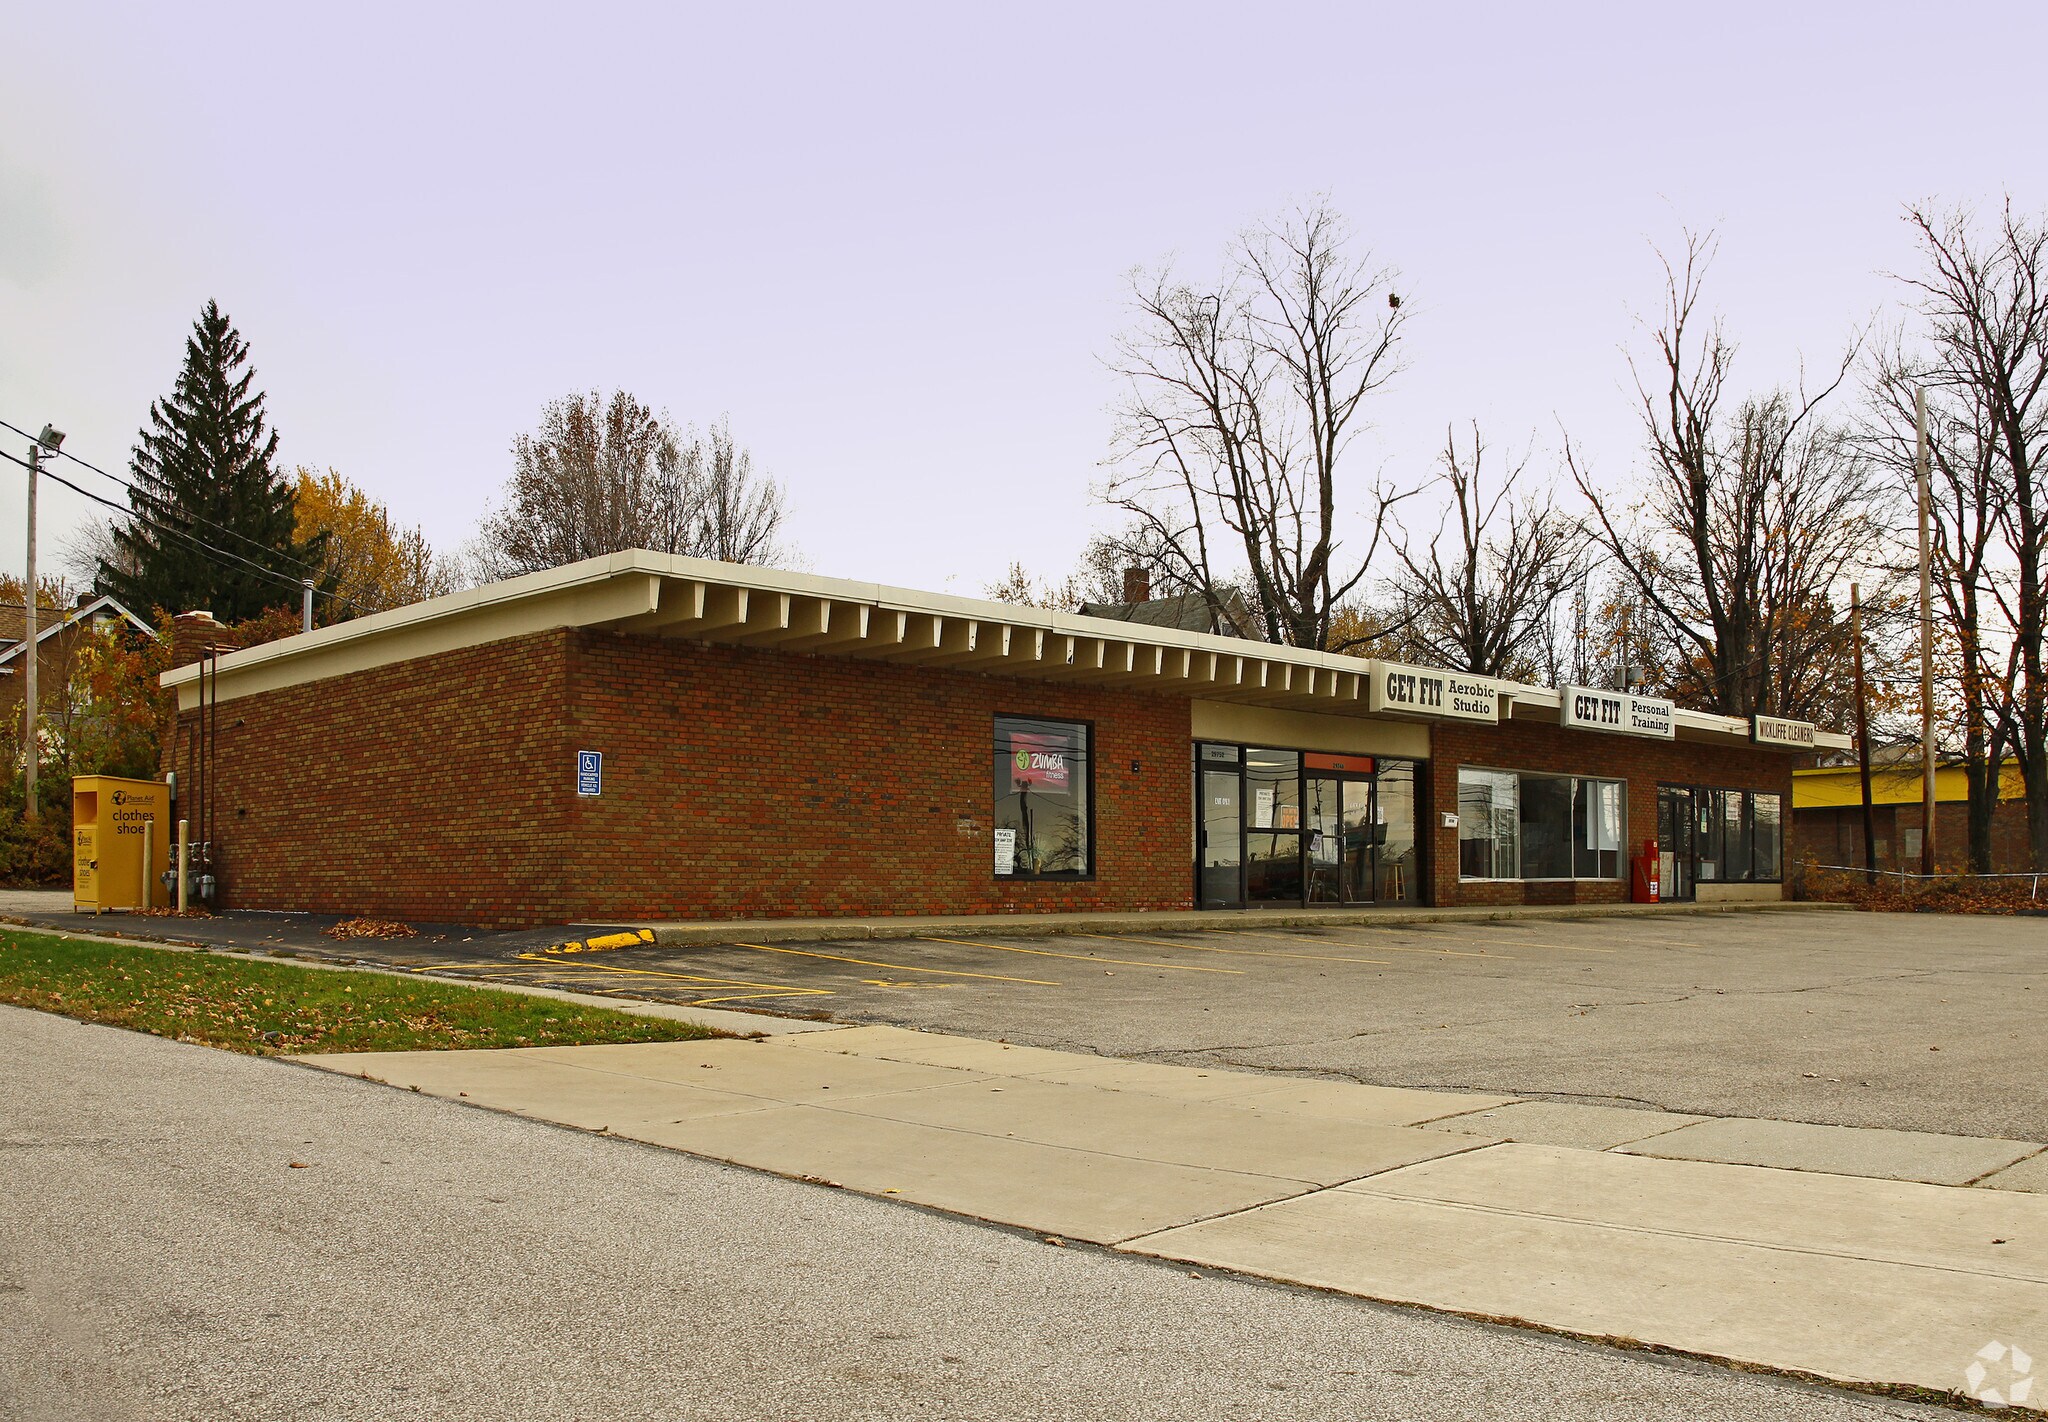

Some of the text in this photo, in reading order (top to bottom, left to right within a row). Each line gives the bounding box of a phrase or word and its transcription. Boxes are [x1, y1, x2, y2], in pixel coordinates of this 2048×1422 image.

[1387, 672, 1442, 706] GET FIT
[1448, 680, 1494, 698] Aerobic
[1453, 698, 1490, 714] Studio
[1575, 695, 1620, 724] GET FIT
[1631, 701, 1669, 716] Personal
[1632, 715, 1669, 733] Training
[1759, 721, 1813, 743] WICKLIFFE CLEANERS
[1031, 753, 1064, 770] ZUMBA
[1046, 771, 1064, 779] fitness
[112, 809, 154, 821] clothes
[117, 822, 145, 834] shoe
